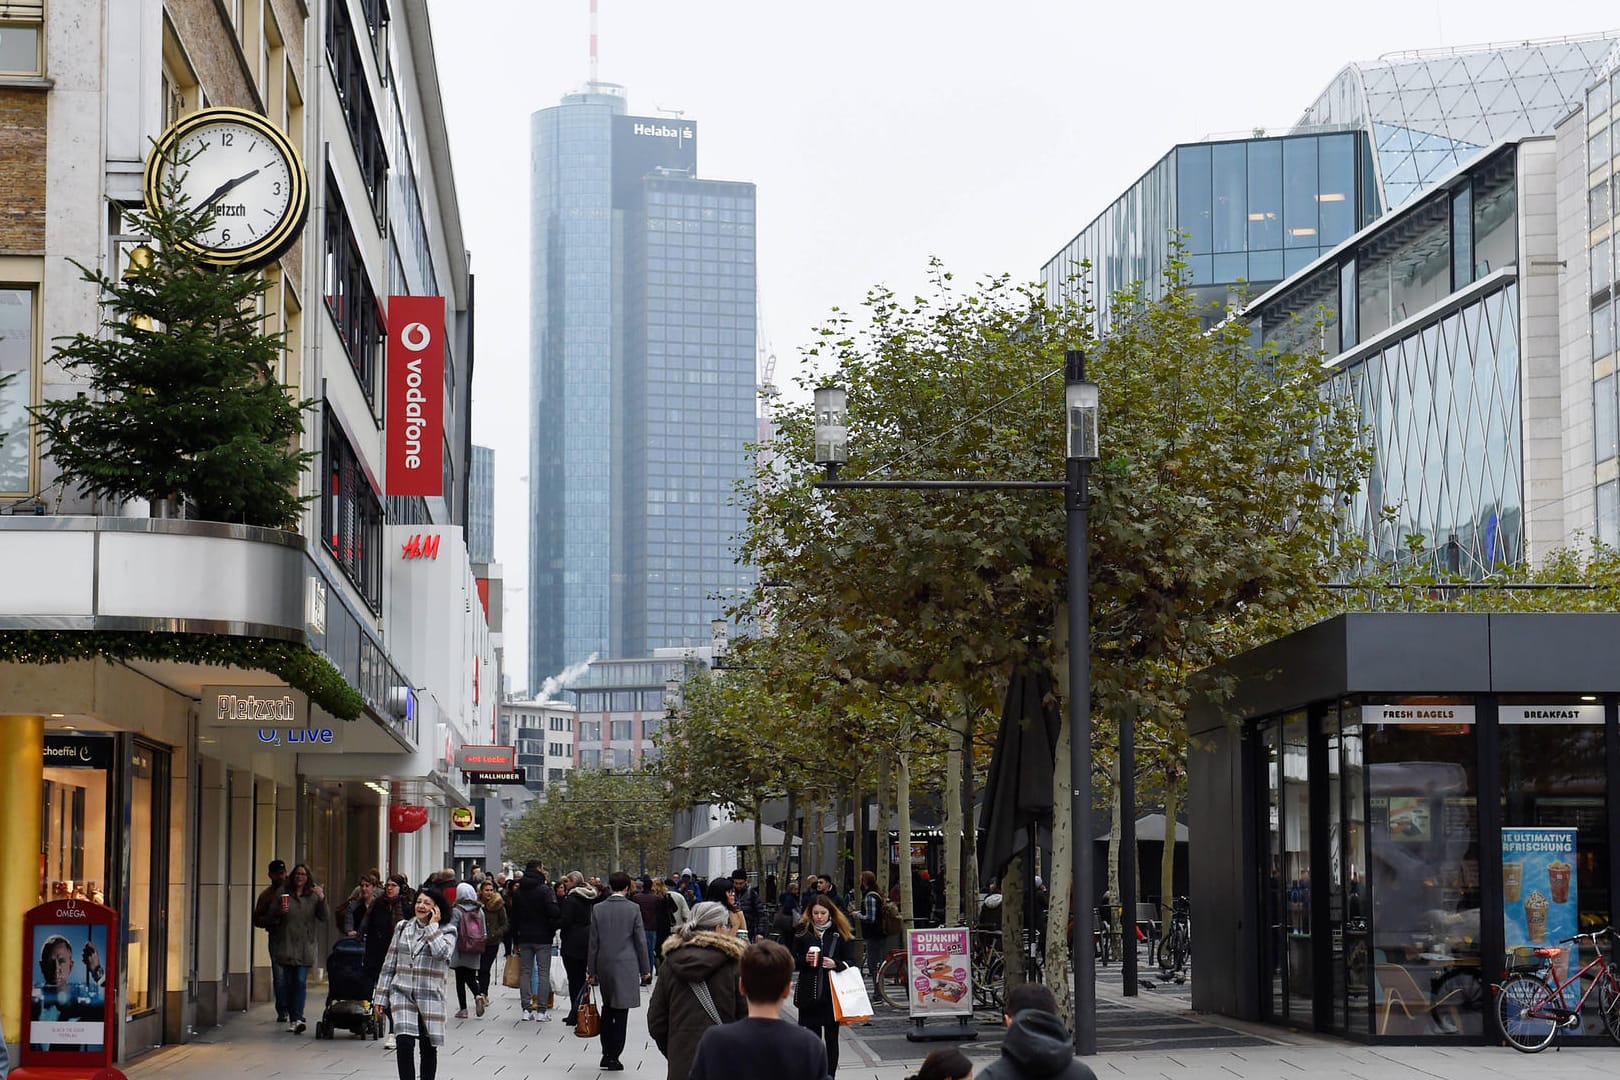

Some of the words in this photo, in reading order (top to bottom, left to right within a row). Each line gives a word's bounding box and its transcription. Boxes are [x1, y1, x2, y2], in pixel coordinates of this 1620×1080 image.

[634, 124, 678, 137] Helaba
[221, 133, 234, 147] 12
[272, 181, 281, 196] 3
[221, 228, 231, 242] 6
[405, 358, 427, 470] vodafone
[402, 534, 441, 561] H&M
[1383, 710, 1414, 719] FRESH
[1416, 710, 1454, 719] BAGELS
[1523, 710, 1580, 719] BREAKFAST
[43, 744, 77, 757] choeffel
[1503, 834, 1512, 842] IE
[1514, 834, 1572, 842] ULTIMATIVE
[1503, 843, 1572, 852] RFRISCHUNG
[56, 909, 86, 918] OMEGA
[917, 934, 962, 943] DUNKIN'
[917, 943, 945, 952] DEAL
